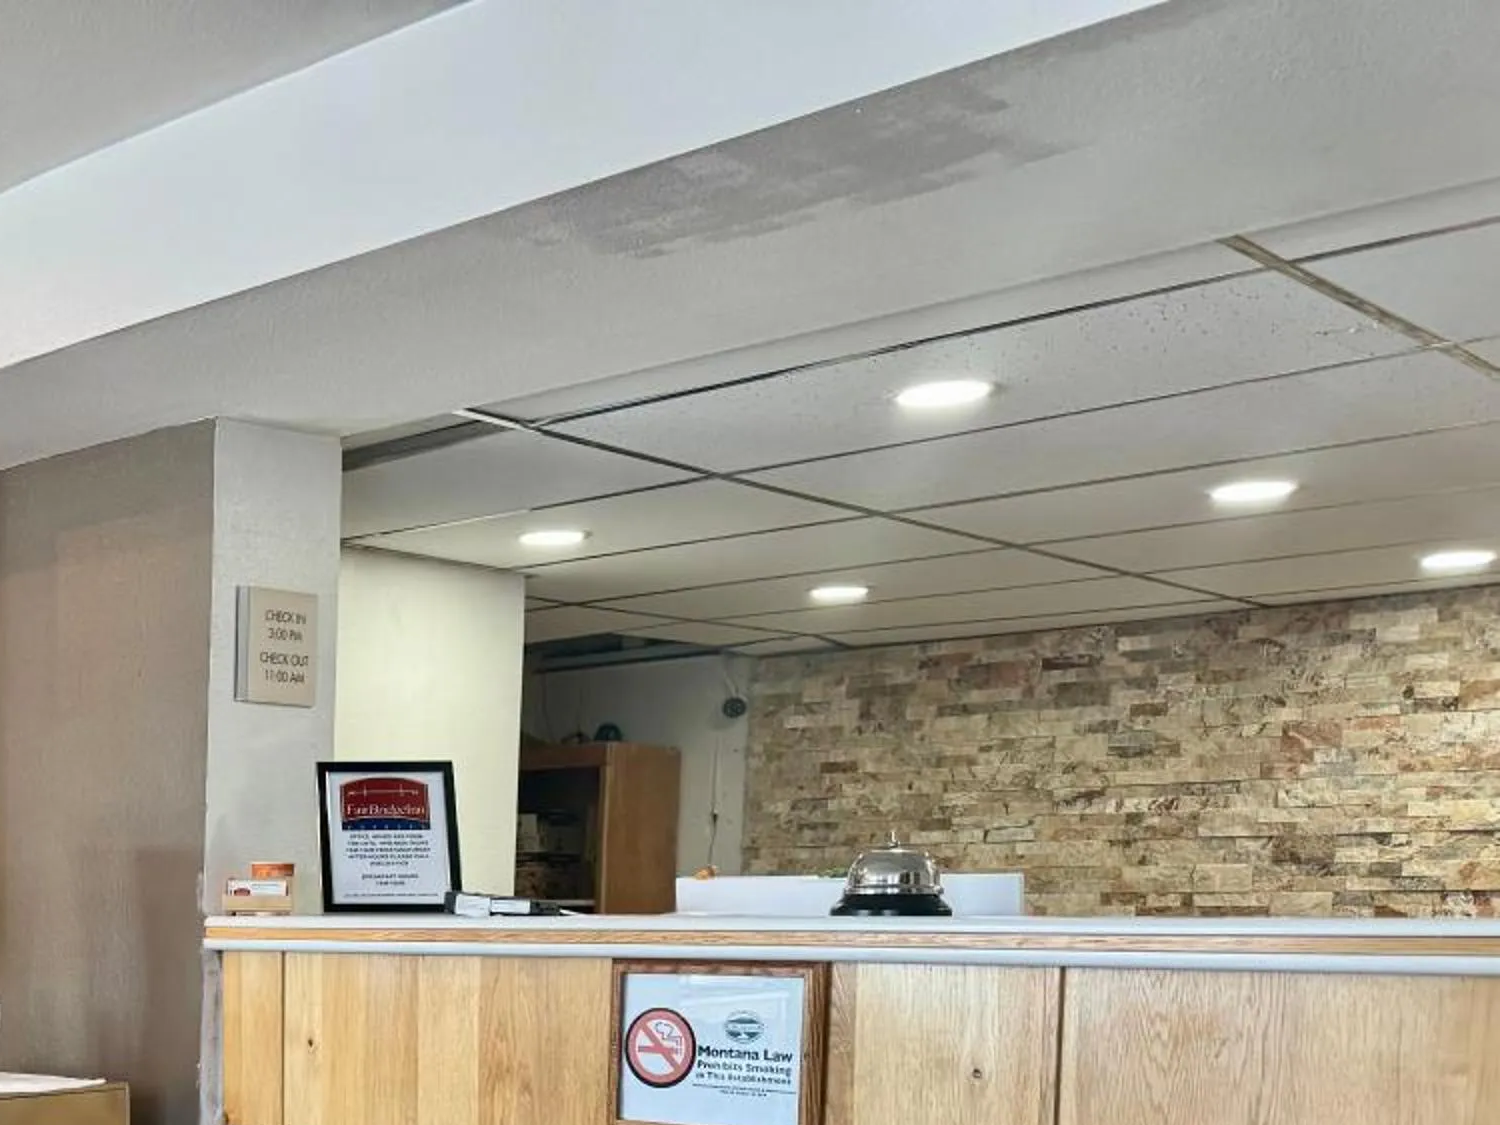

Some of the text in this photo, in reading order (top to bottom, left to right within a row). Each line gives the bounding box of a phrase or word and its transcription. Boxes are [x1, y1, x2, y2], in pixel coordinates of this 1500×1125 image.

[265, 609, 307, 624] CHECK IN
[260, 651, 308, 667] CHECK OUT
[289, 671, 305, 683] AM
[698, 1045, 793, 1063] Montana Law
[697, 1059, 792, 1077] Prohibits Smoking
